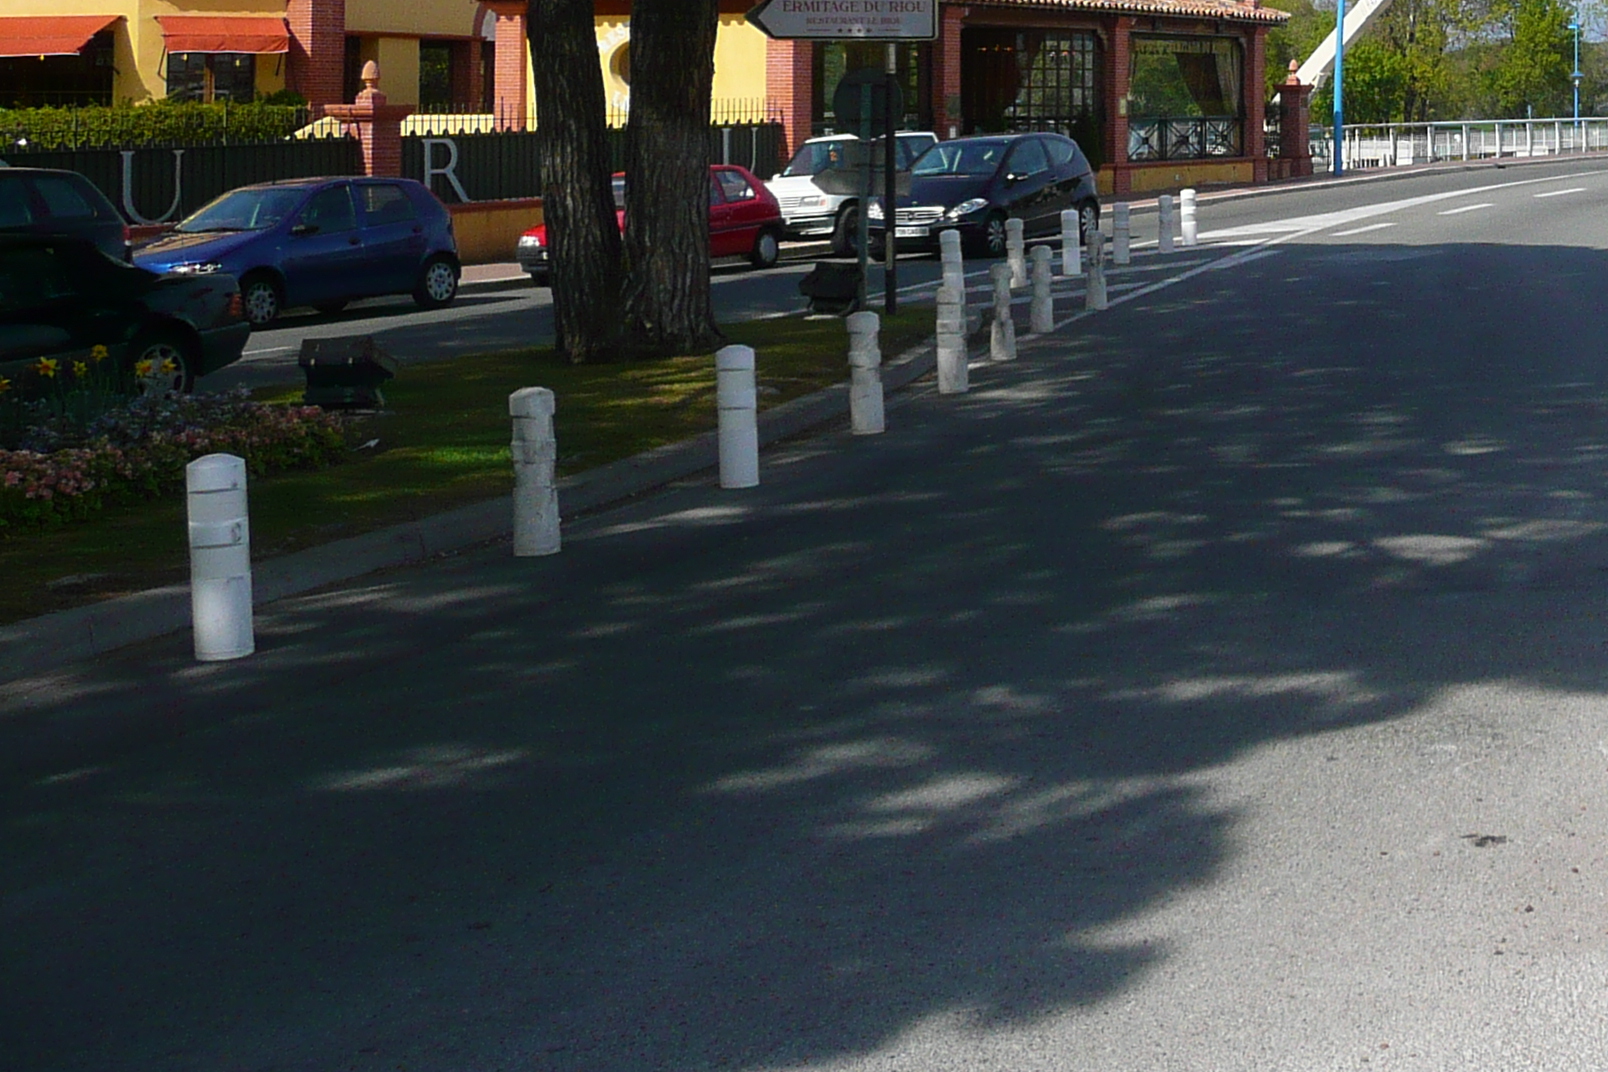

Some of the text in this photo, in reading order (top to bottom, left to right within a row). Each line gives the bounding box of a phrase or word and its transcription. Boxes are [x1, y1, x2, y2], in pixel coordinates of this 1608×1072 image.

[782, 0, 926, 13] ERMITAGE DU RIOU
[806, 16, 865, 25] RESTAURANT
